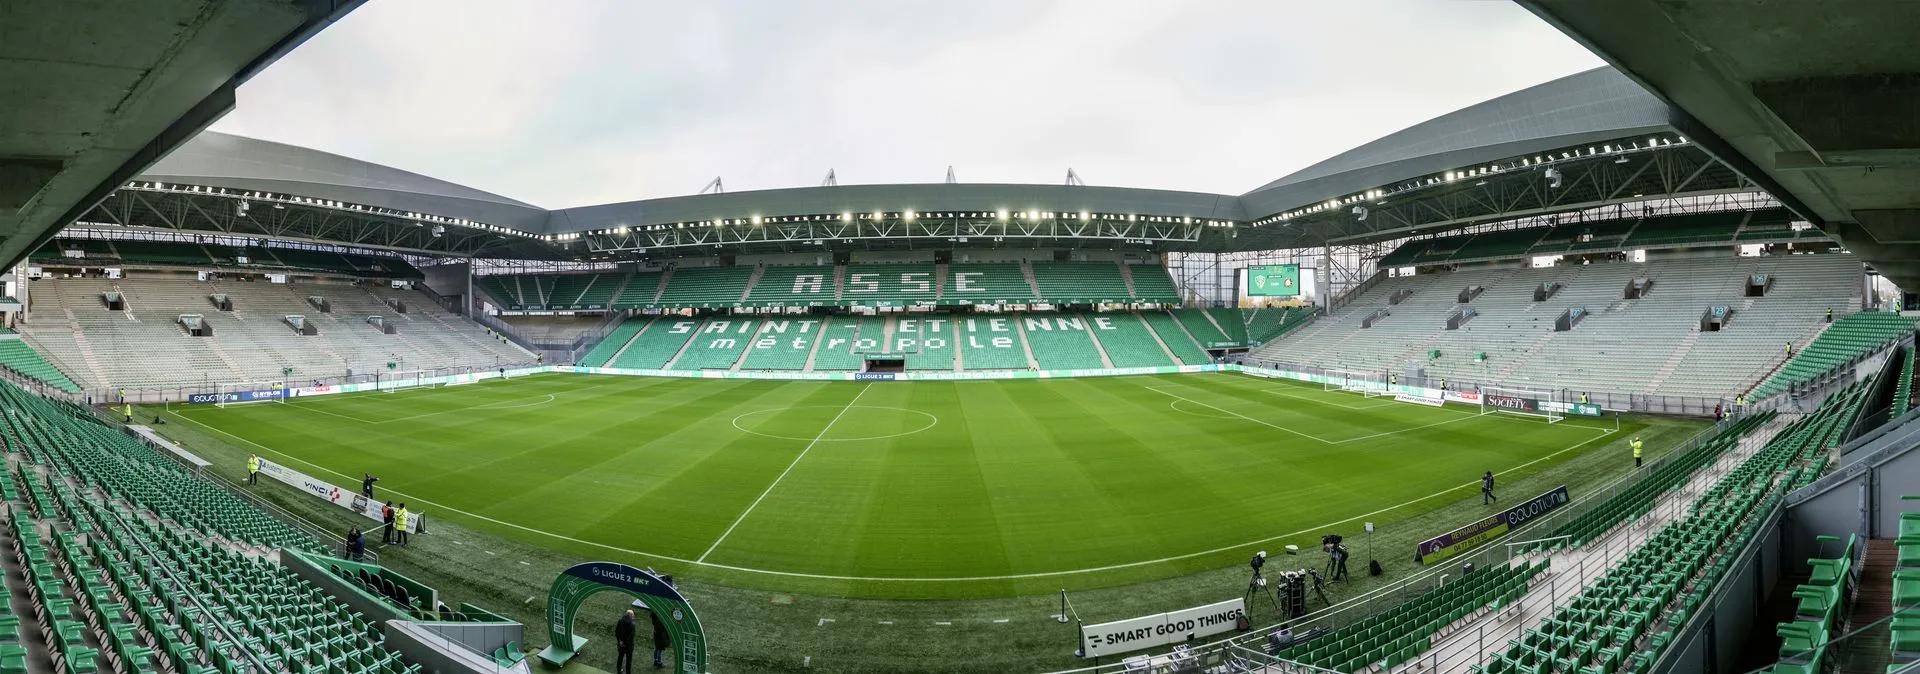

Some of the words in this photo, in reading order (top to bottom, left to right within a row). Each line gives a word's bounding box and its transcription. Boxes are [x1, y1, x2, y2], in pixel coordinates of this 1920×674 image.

[792, 272, 986, 293] ASSE
[1487, 395, 1526, 409] SOCIETY
[304, 480, 328, 496] VINCI
[1451, 523, 1479, 541] REYNAUD
[1479, 517, 1498, 529] FLEURS
[601, 569, 626, 582] LIGUE
[626, 575, 632, 583] 2
[633, 576, 650, 586] BKT
[1106, 626, 1153, 645] SMART
[1156, 619, 1195, 636] GOOD
[1198, 608, 1243, 628] THINGS
